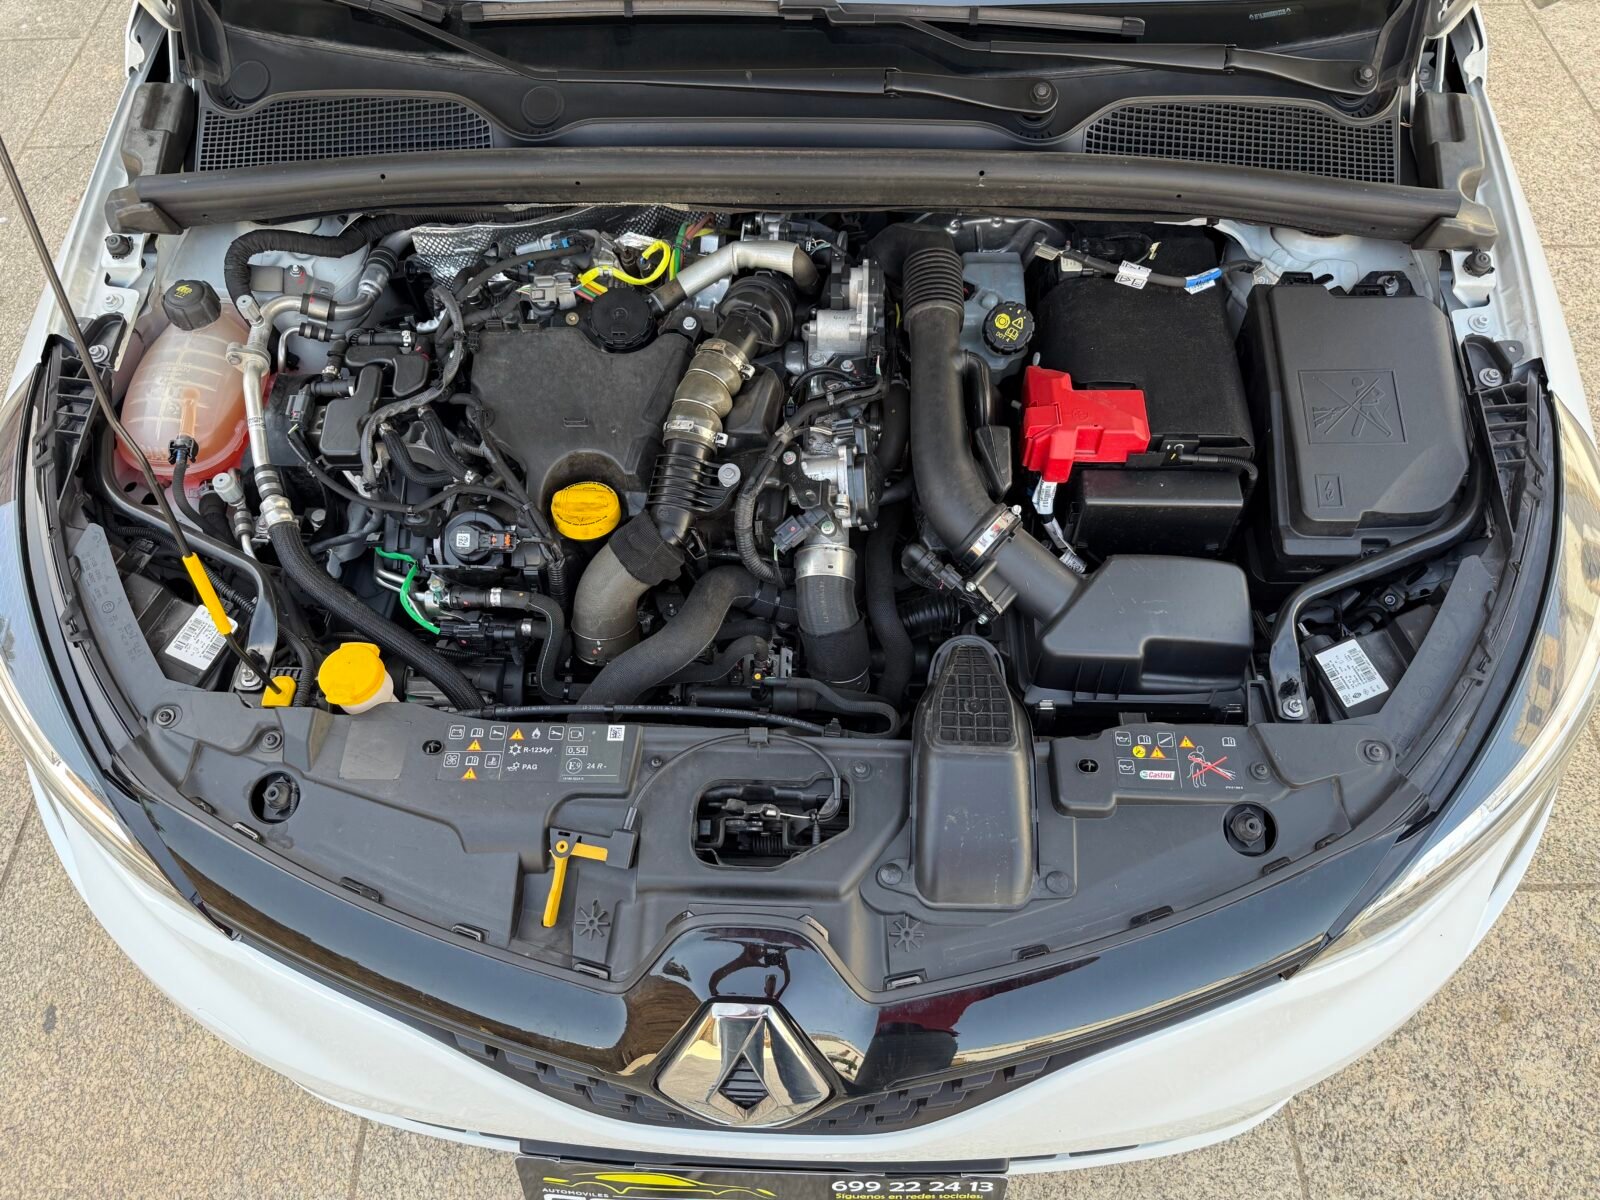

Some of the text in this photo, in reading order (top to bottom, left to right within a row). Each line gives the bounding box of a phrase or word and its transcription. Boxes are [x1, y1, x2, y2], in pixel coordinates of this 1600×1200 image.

[523, 746, 553, 755] R-1234yf
[521, 763, 538, 771] PAG
[1148, 771, 1172, 779] Castrol
[831, 1180, 994, 1192] 699 22 24 13
[542, 1187, 609, 1198] AUTOMOVILES
